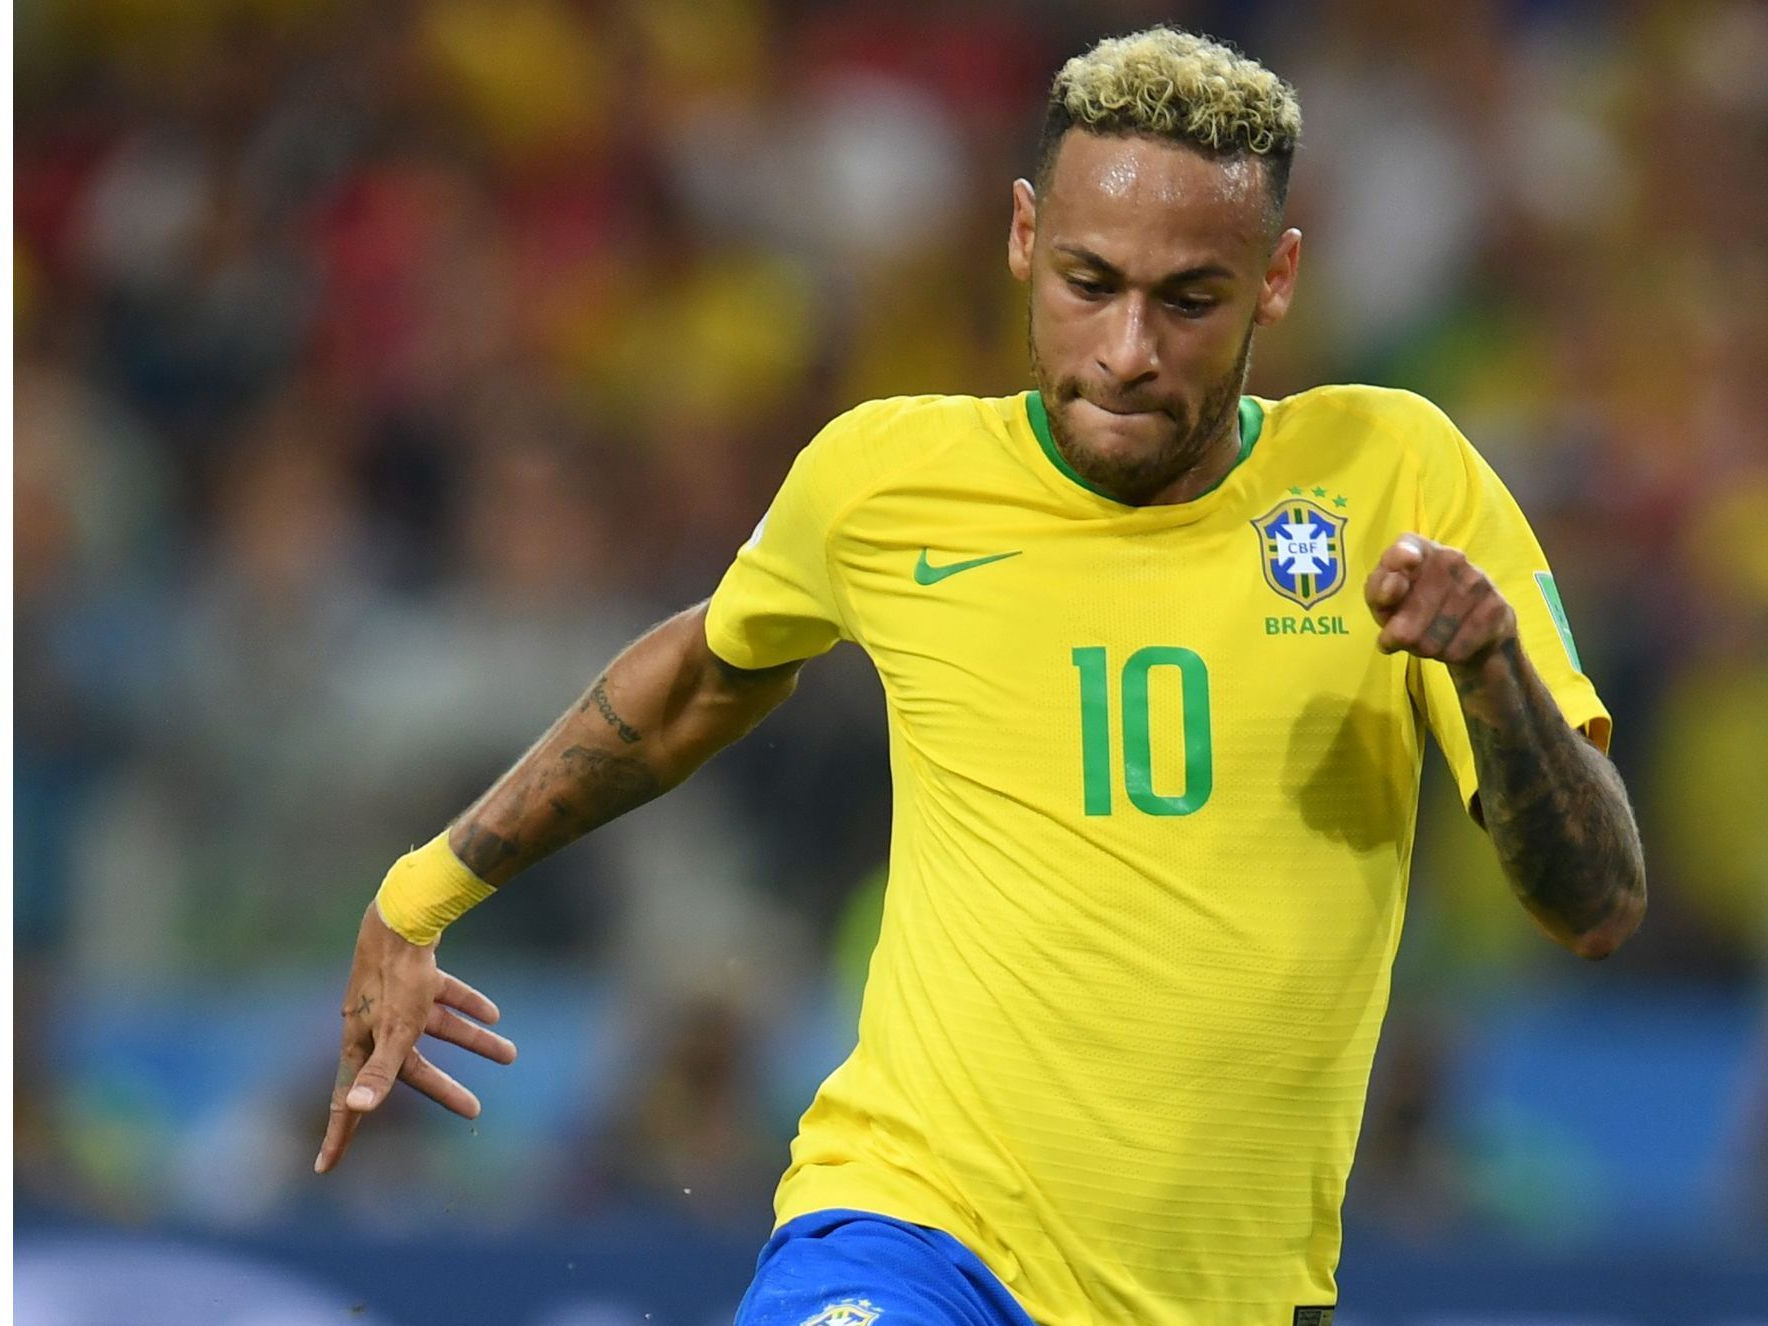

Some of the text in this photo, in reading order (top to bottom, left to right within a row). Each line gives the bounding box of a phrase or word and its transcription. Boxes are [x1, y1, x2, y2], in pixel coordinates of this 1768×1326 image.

[1287, 542, 1320, 554] CBF
[1264, 616, 1350, 635] BRASIL
[1071, 645, 1213, 817] 10
